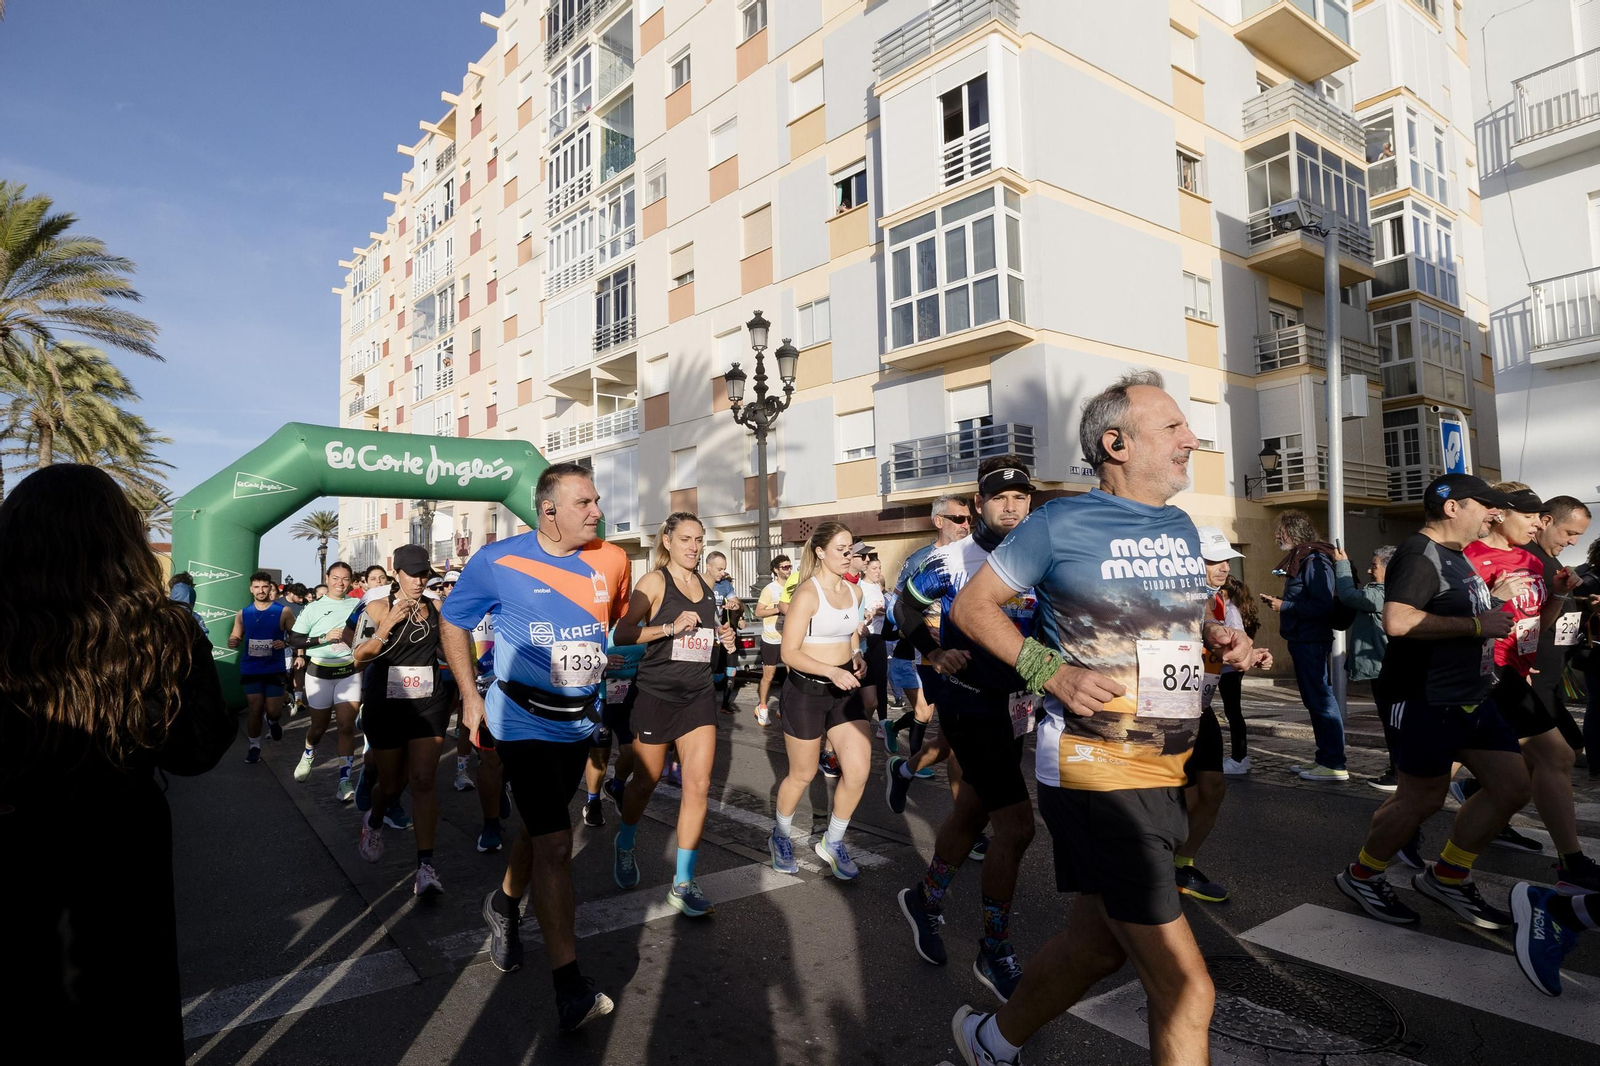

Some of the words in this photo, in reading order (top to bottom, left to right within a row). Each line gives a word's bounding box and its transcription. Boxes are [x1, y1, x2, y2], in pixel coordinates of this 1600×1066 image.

[325, 441, 355, 469] El
[357, 445, 424, 475] Corte
[425, 445, 513, 486] Inglés
[1081, 467, 1095, 476] FELI
[1110, 534, 1190, 557] media
[1143, 580, 1176, 591] CIUDAD
[1180, 578, 1191, 588] DE
[560, 621, 608, 640] KAEFE
[1523, 627, 1537, 642] 21
[680, 636, 708, 651] 1693
[559, 655, 601, 671] 1333
[403, 676, 421, 688] 98
[1163, 664, 1200, 691] 825
[614, 685, 630, 695] 27
[1534, 907, 1545, 940] HOKA
